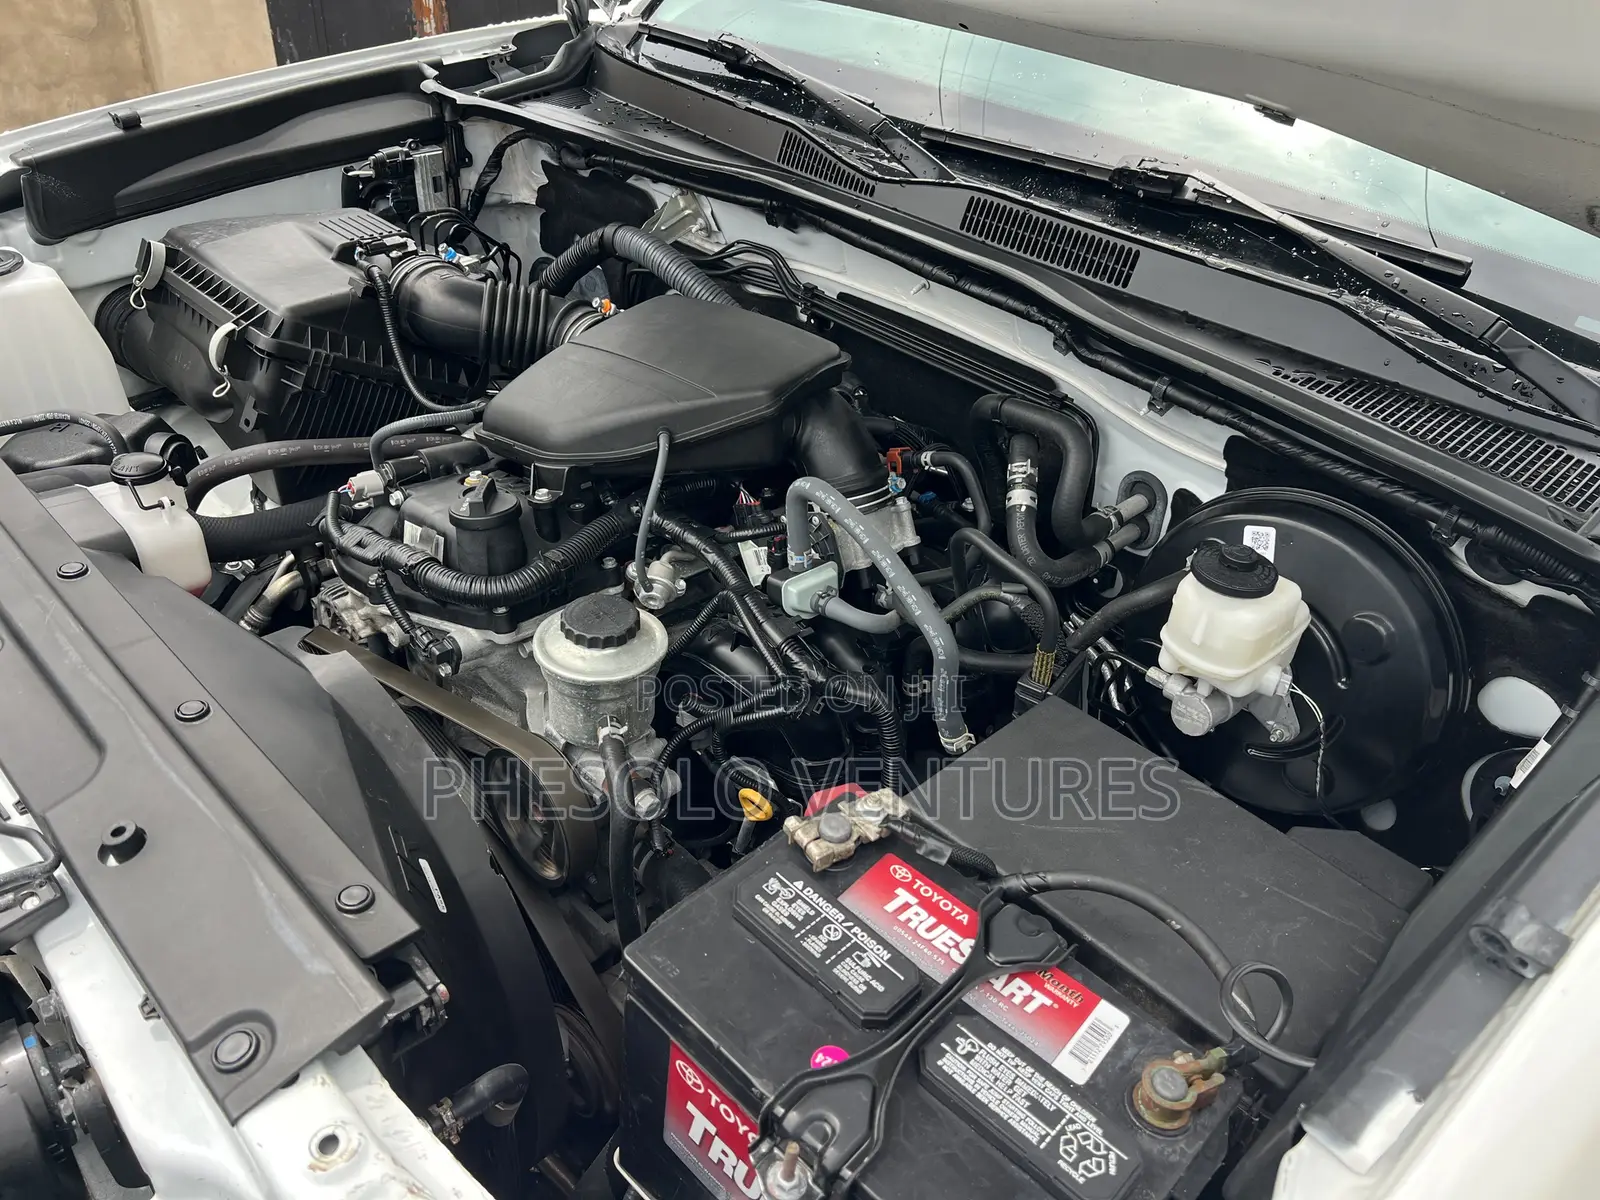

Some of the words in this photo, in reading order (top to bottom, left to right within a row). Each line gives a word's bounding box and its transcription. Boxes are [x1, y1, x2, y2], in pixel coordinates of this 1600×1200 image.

[910, 879, 970, 925] TOYOTA
[802, 886, 845, 923] DANGER
[850, 925, 891, 961] POISON
[844, 957, 871, 981] SULFURIC
[869, 978, 885, 992] ACID
[1035, 966, 1086, 1004] Month
[1043, 982, 1079, 1009] WARRANTY
[969, 1058, 996, 1082] MEDICAL
[995, 1079, 1013, 1095] HELP
[1012, 1091, 1031, 1109] FAST
[973, 1053, 991, 1070] WITH
[990, 1066, 1012, 1086] WATER
[978, 1048, 999, 1068] FLUSH
[998, 1064, 1015, 1080] EYES
[1014, 1077, 1057, 1113] IMMEDIATELY
[1065, 1122, 1082, 1132] LEAD
[1057, 1159, 1086, 1184] RECYCLE
